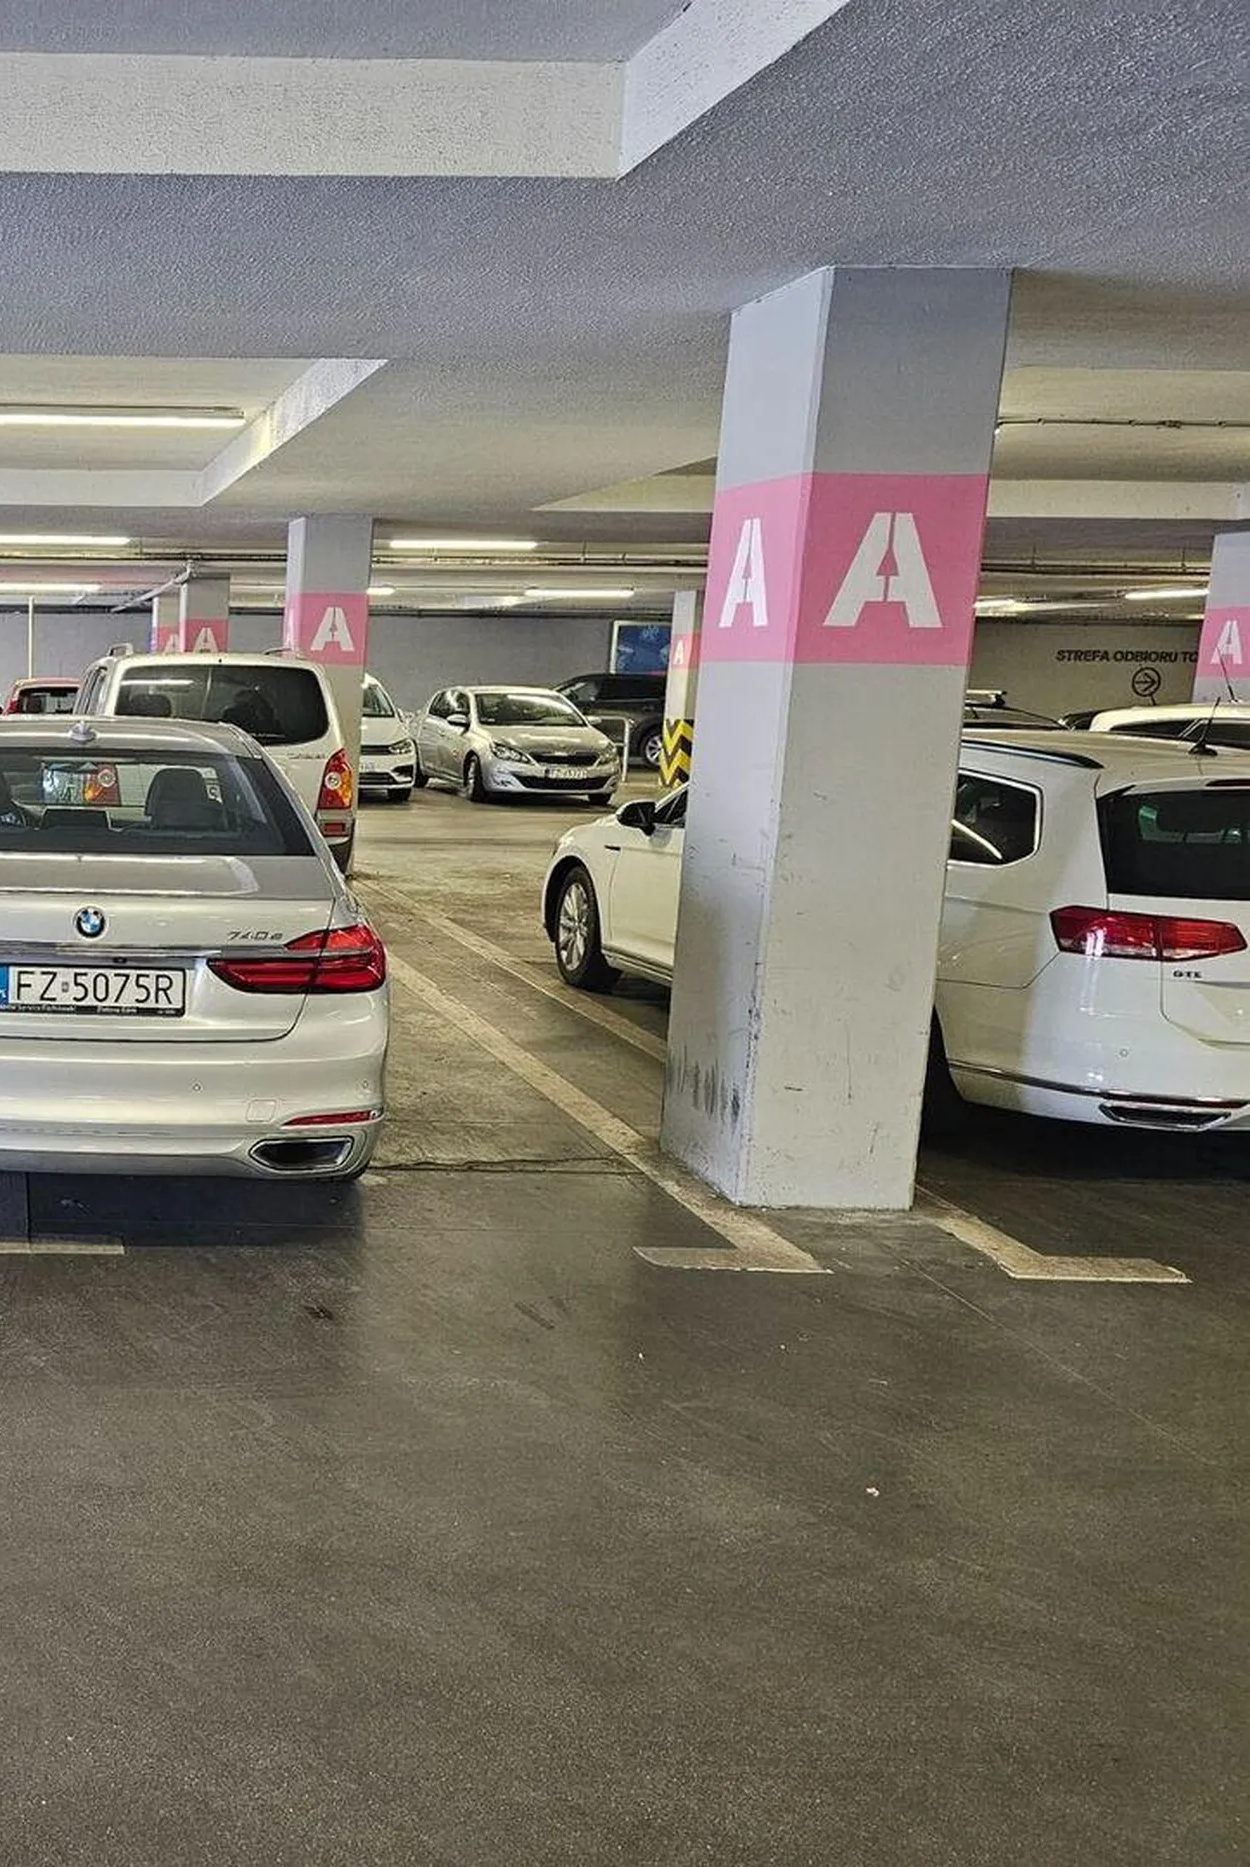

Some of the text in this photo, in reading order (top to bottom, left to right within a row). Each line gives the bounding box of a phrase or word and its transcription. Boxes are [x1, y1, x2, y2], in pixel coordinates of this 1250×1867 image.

[718, 518, 768, 627] A
[822, 512, 942, 627] A
[192, 627, 219, 653] A
[310, 606, 355, 651] A
[1210, 620, 1242, 664] A
[672, 641, 685, 665] A
[1056, 649, 1110, 662] STREFA
[1113, 650, 1179, 663] ODBIORU
[17, 971, 173, 1004] FZ 5075R
[1173, 970, 1202, 979] GTE
